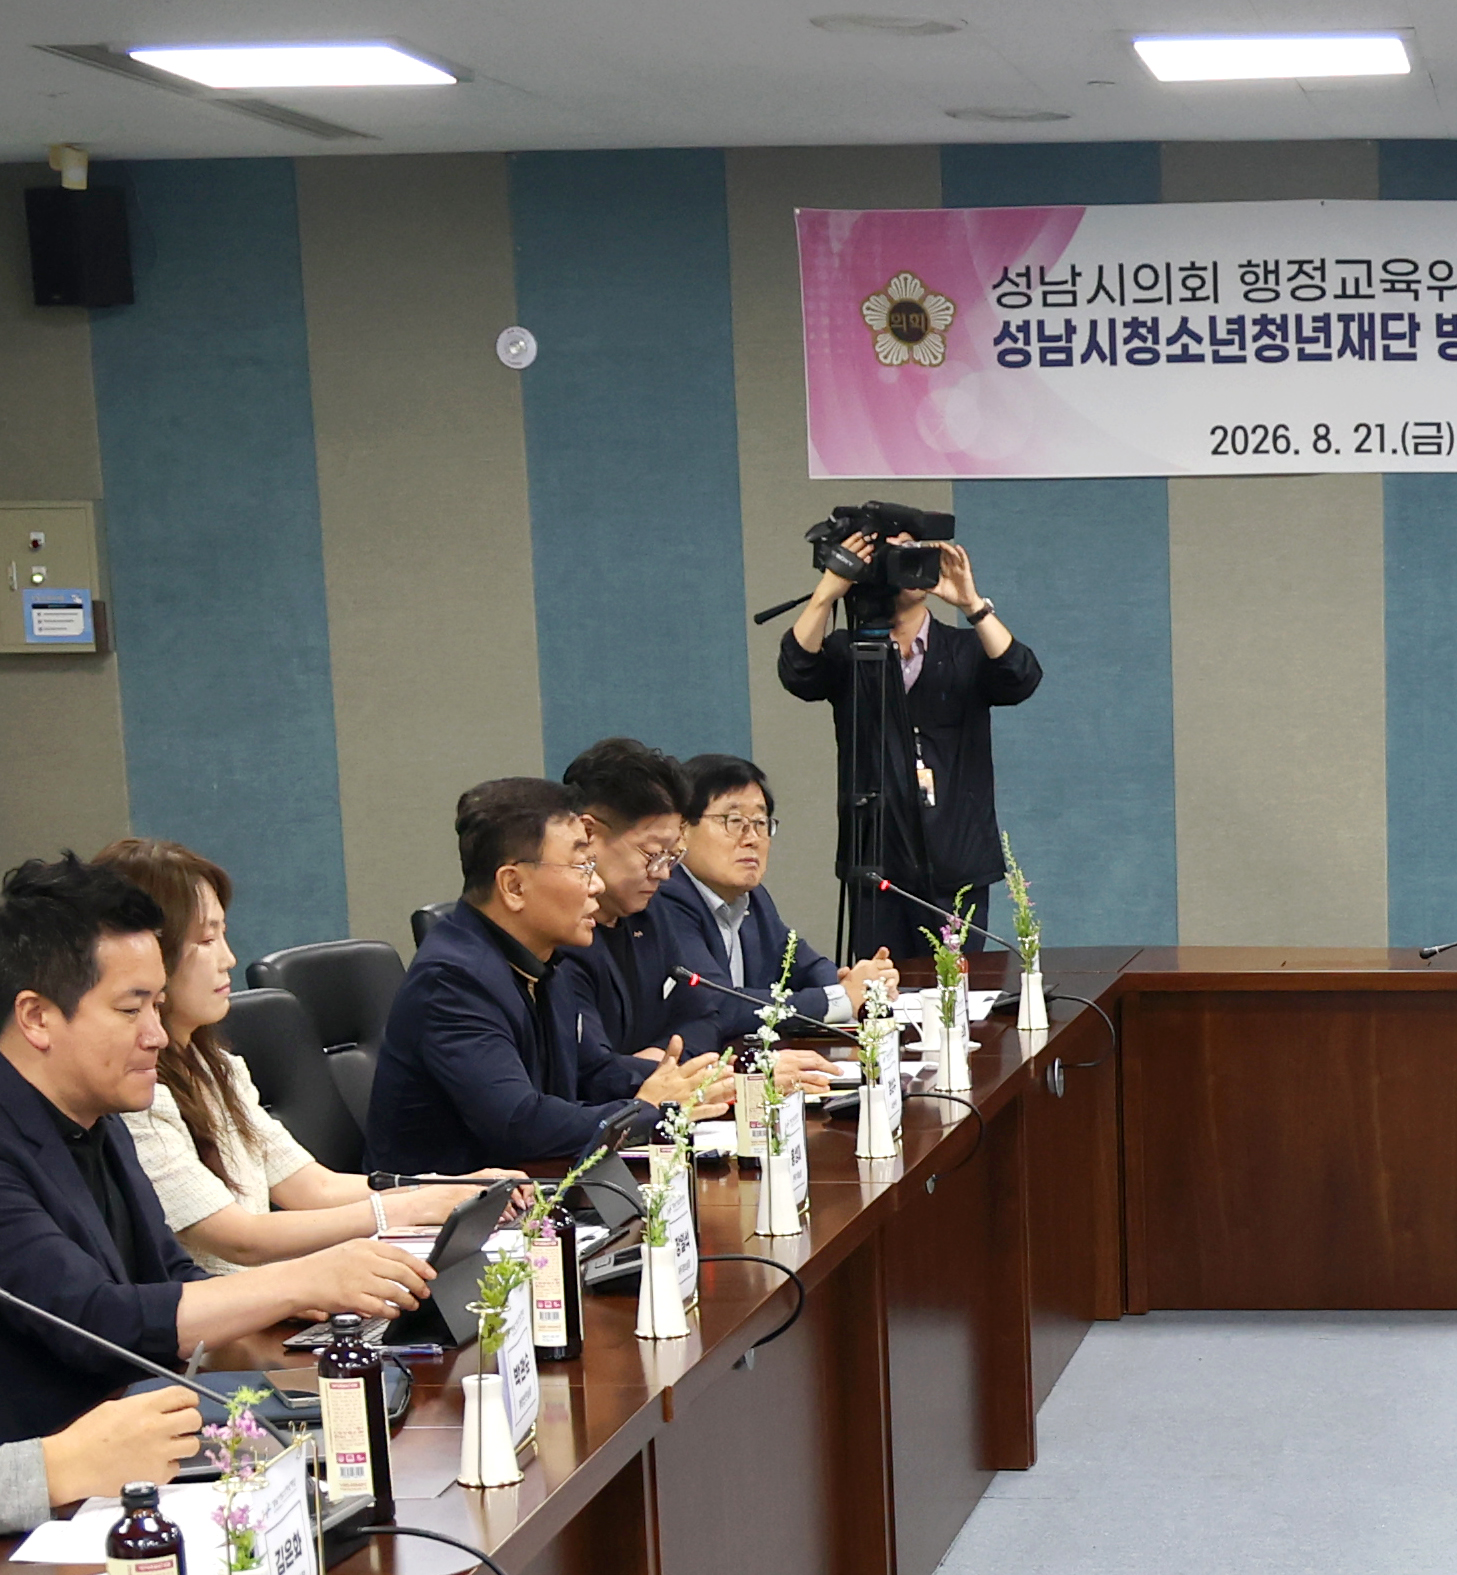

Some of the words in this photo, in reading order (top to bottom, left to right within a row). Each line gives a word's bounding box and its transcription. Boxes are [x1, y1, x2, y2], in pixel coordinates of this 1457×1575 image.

[991, 259, 1220, 309] 성남시의회
[991, 312, 1420, 369] 성남시청소년청년재단
[1209, 425, 1301, 457] 2026.
[1311, 425, 1341, 457] 8.
[1352, 420, 1455, 457] 21.(금)
